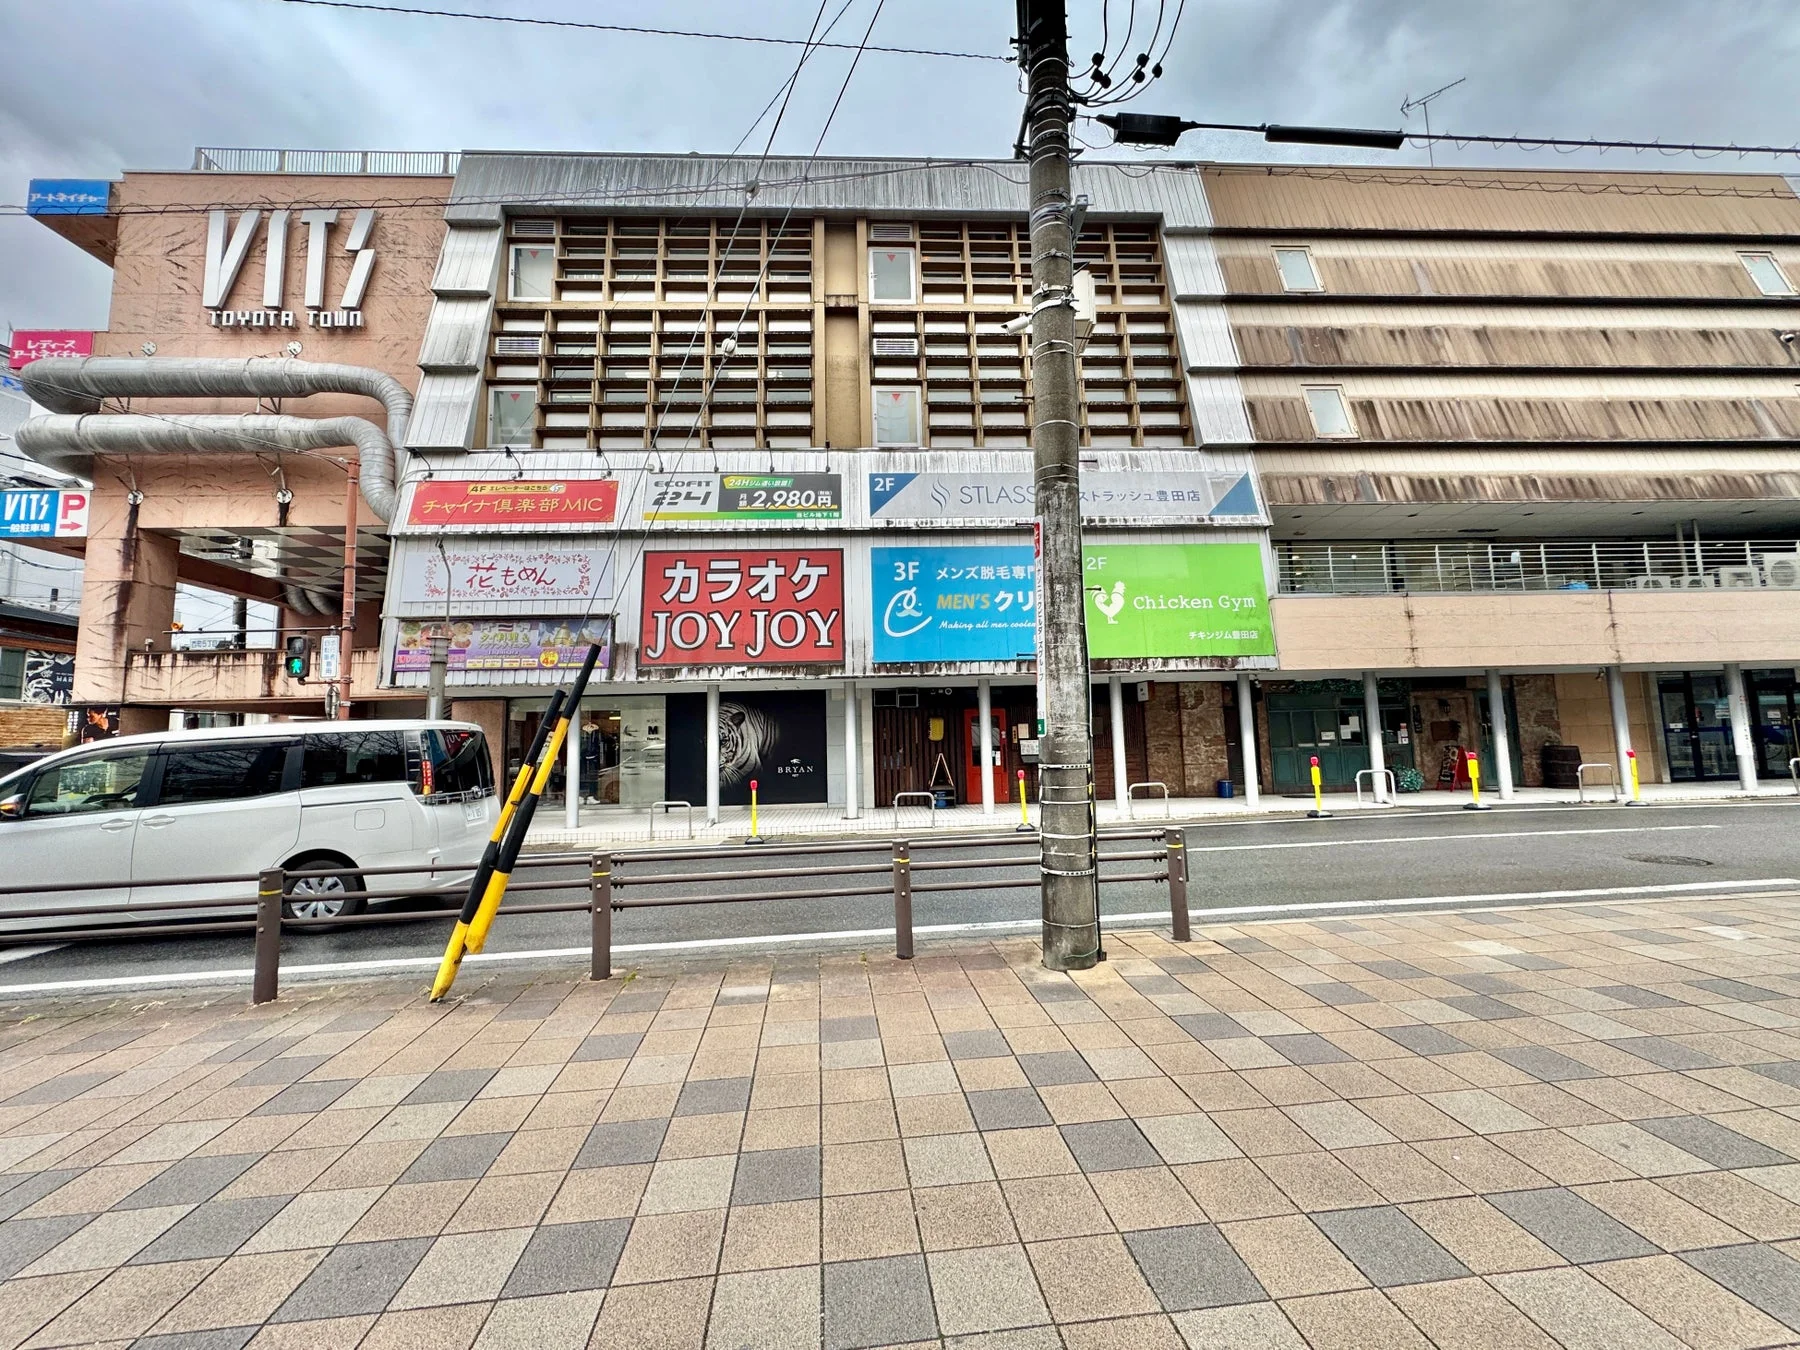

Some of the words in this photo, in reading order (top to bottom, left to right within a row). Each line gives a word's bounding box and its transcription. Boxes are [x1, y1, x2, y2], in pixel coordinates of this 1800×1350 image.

[209, 311, 296, 327] TOYOTA
[306, 311, 366, 328] TOWN
[27, 340, 76, 349] レディース
[874, 478, 895, 492] 2F
[62, 494, 86, 519] P
[422, 499, 558, 514] チャイナ倶楽部
[562, 498, 603, 512] MIC
[751, 490, 815, 508] 2,980
[818, 496, 832, 507] 円
[894, 562, 919, 581] 3F
[1086, 557, 1106, 570] 2F
[466, 562, 556, 588] 花もめん
[660, 558, 830, 604] カラオケ
[1133, 595, 1213, 610] Chicken
[1218, 595, 1256, 612] Gym
[645, 610, 742, 659] JOY
[745, 609, 840, 658] JOY
[939, 621, 974, 631] Making
[1189, 631, 1258, 640] チキンジム豊田店
